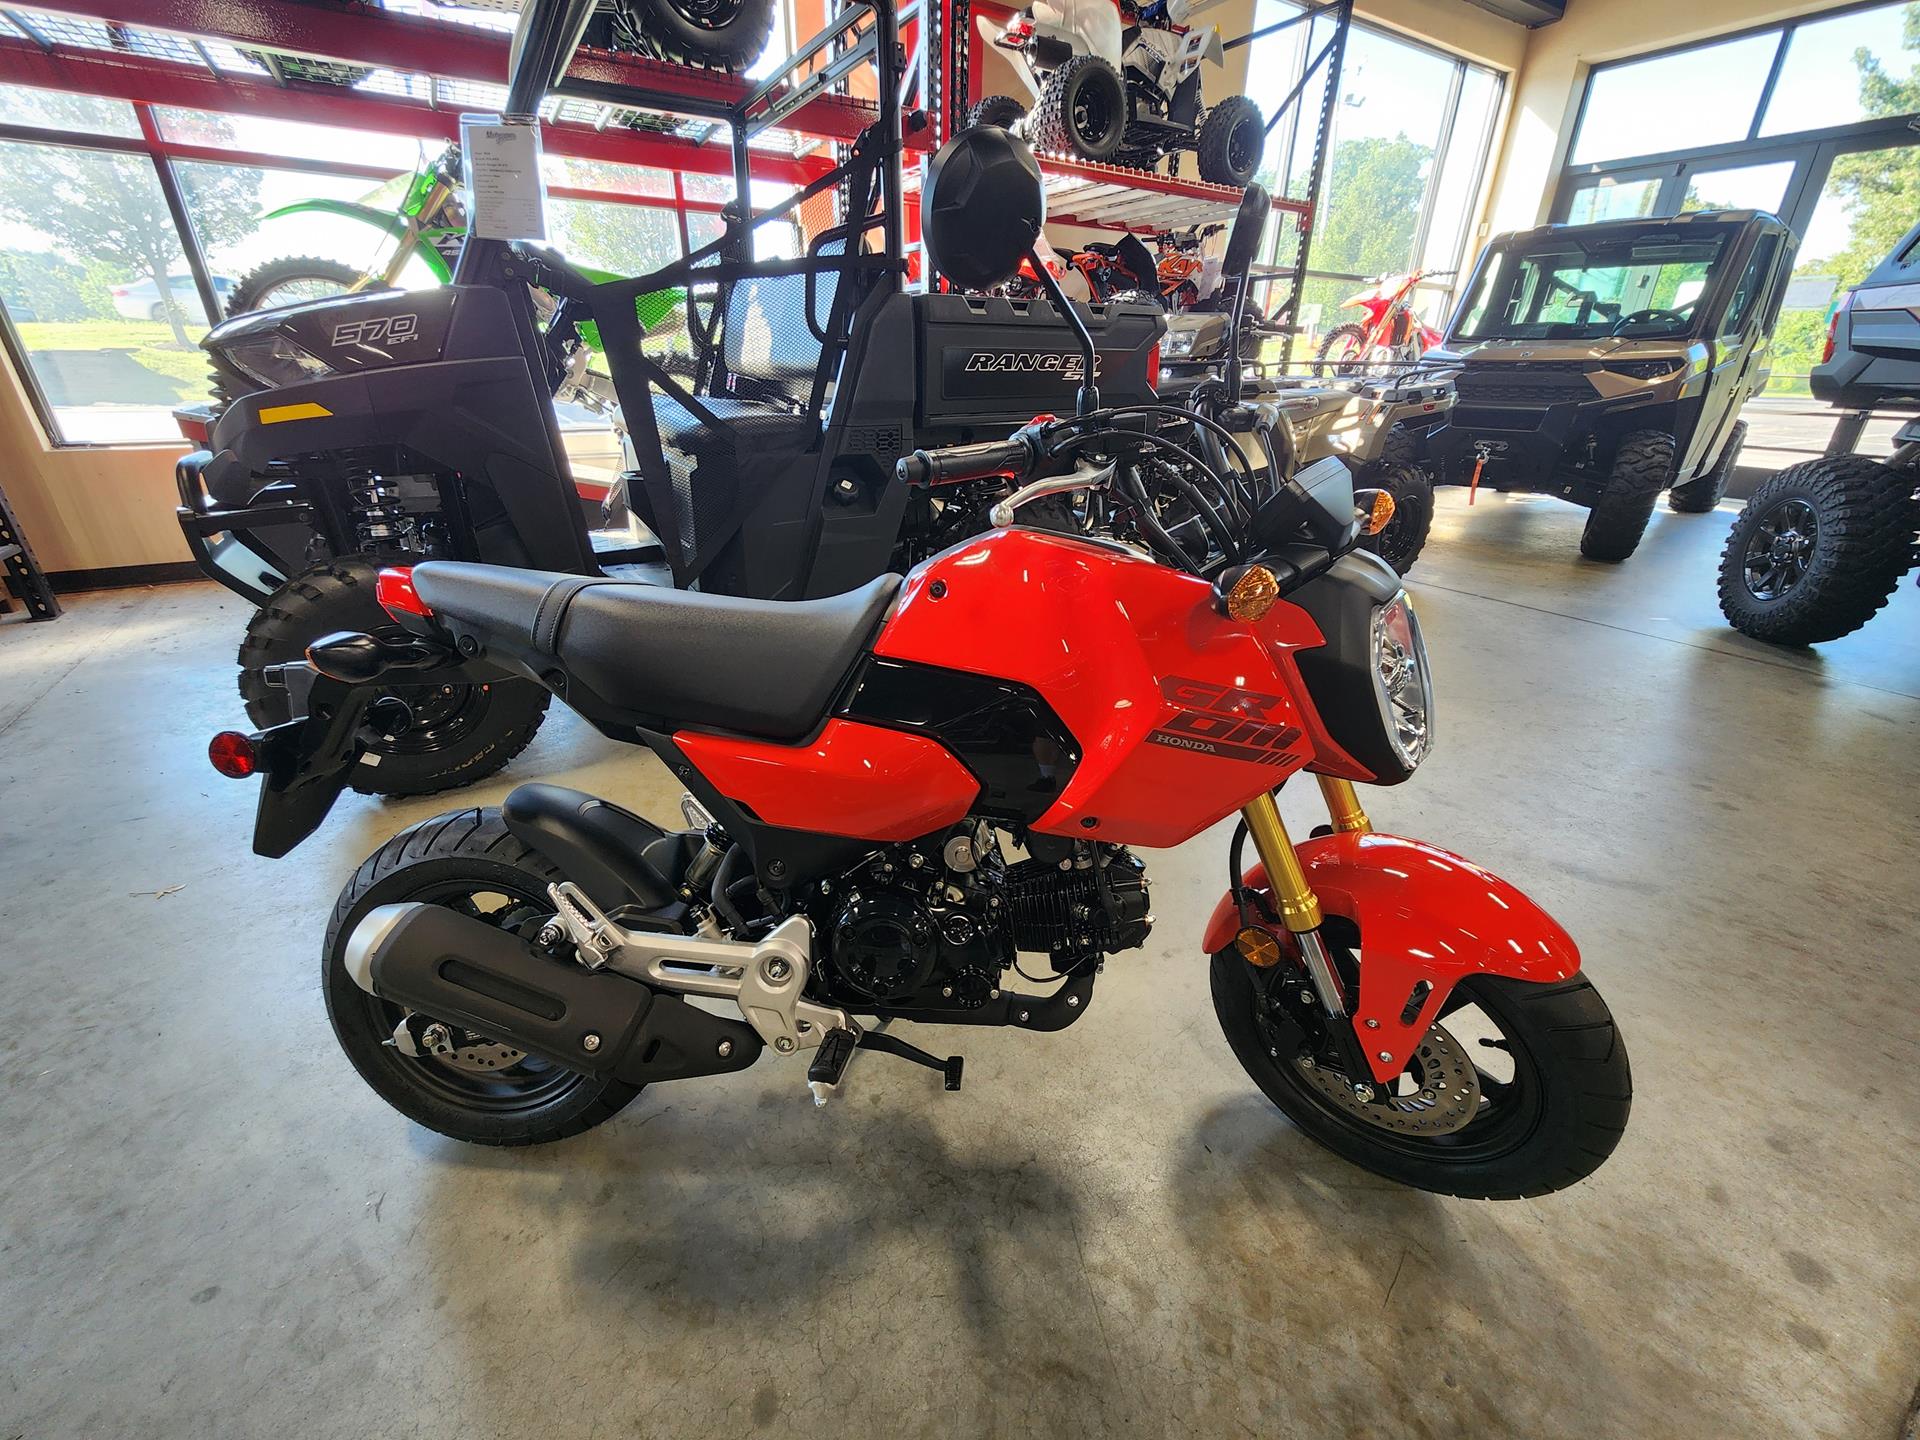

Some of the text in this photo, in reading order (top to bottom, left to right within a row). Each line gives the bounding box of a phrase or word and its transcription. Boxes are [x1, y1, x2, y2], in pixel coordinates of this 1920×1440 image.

[331, 313, 418, 347] 570
[386, 333, 419, 345] EFI
[1155, 733, 1217, 753] HONDA
